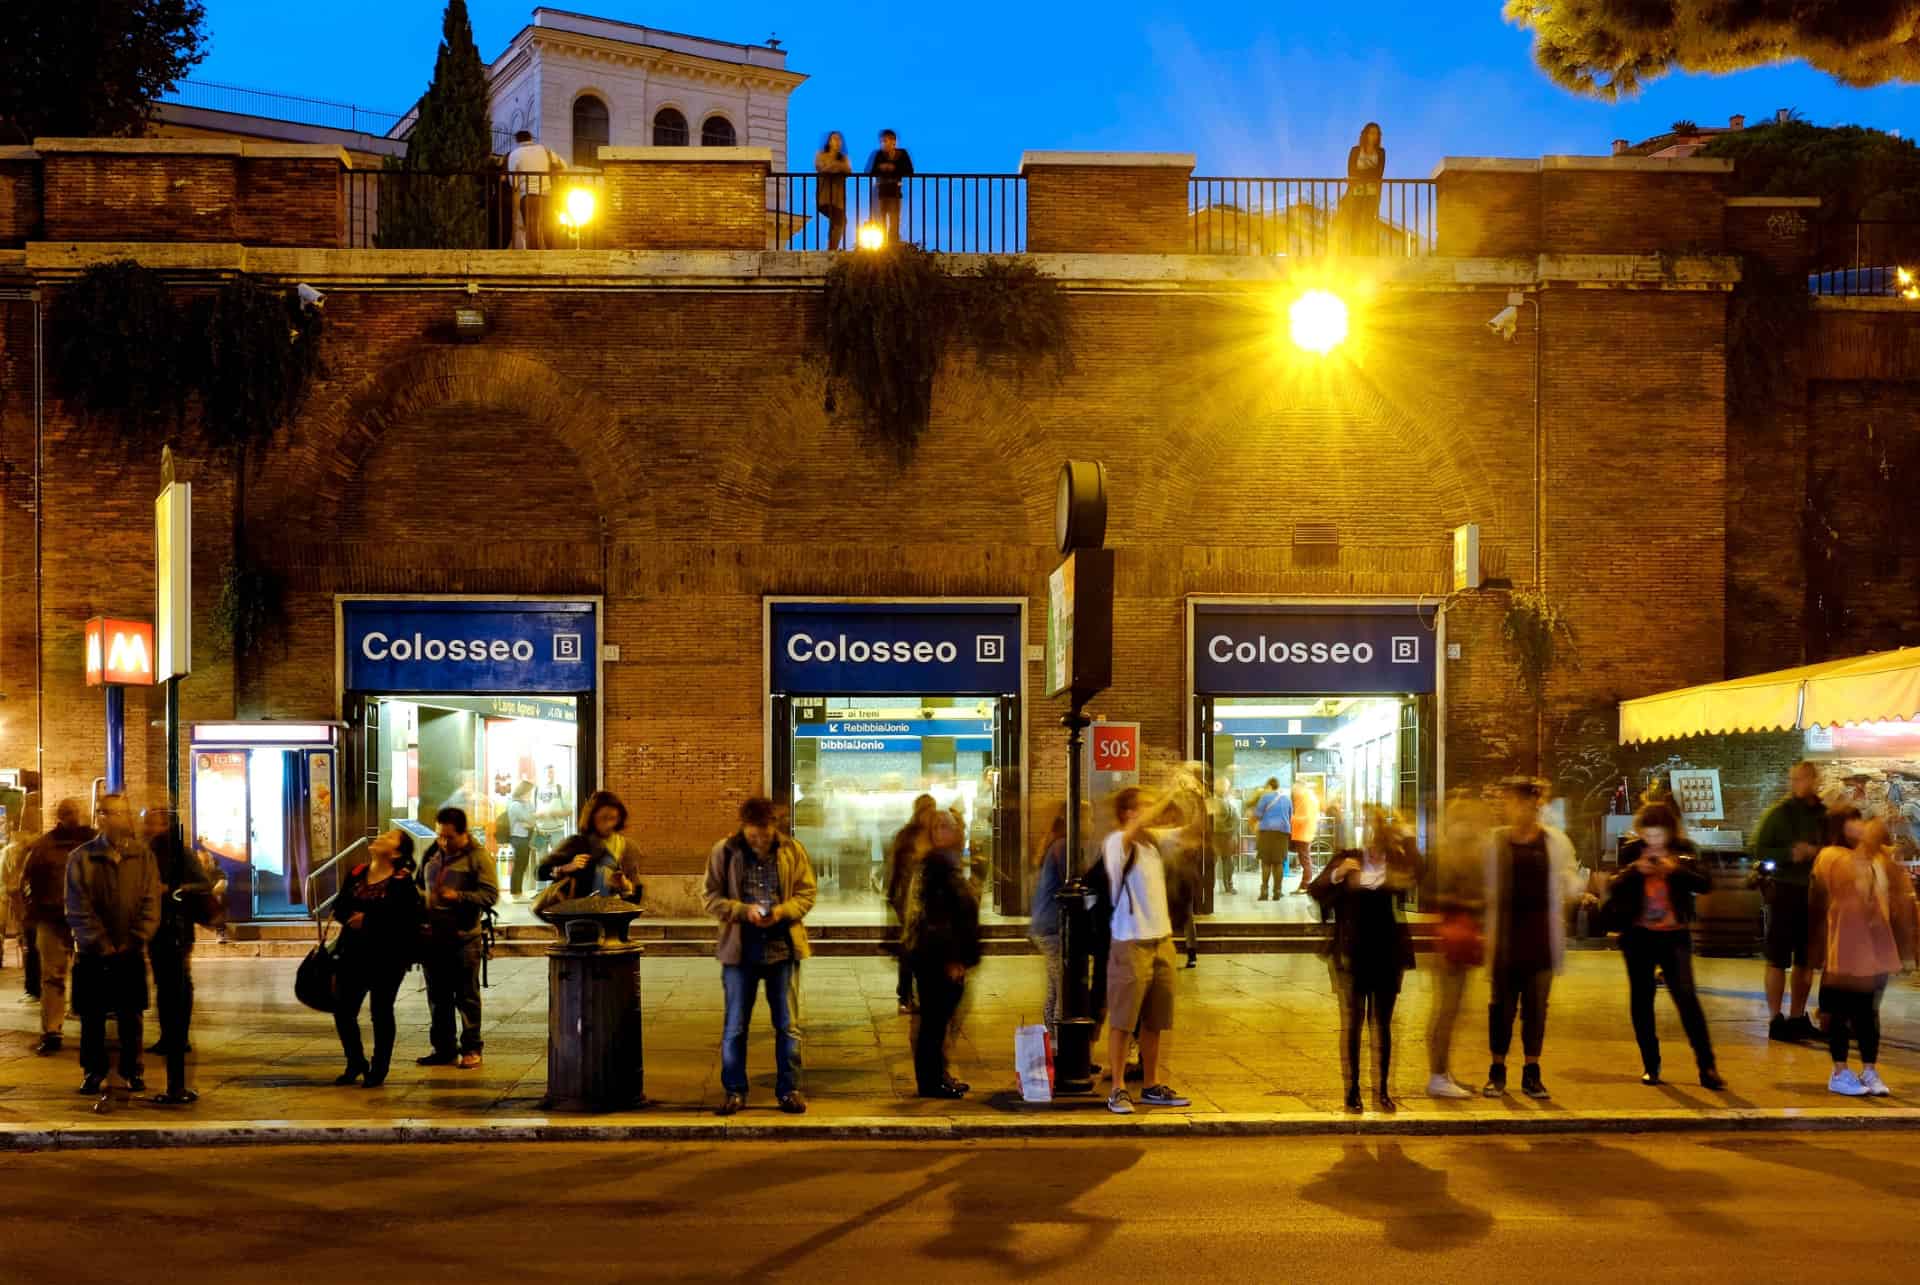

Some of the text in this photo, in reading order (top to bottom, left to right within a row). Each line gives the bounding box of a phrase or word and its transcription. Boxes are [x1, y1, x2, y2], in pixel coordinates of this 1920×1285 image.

[108, 632, 150, 672] M
[362, 632, 573, 661] Colosseo B
[787, 633, 996, 662] Colosseo B
[1208, 635, 1412, 663] Colosseo B
[1100, 740, 1130, 757] SOS
